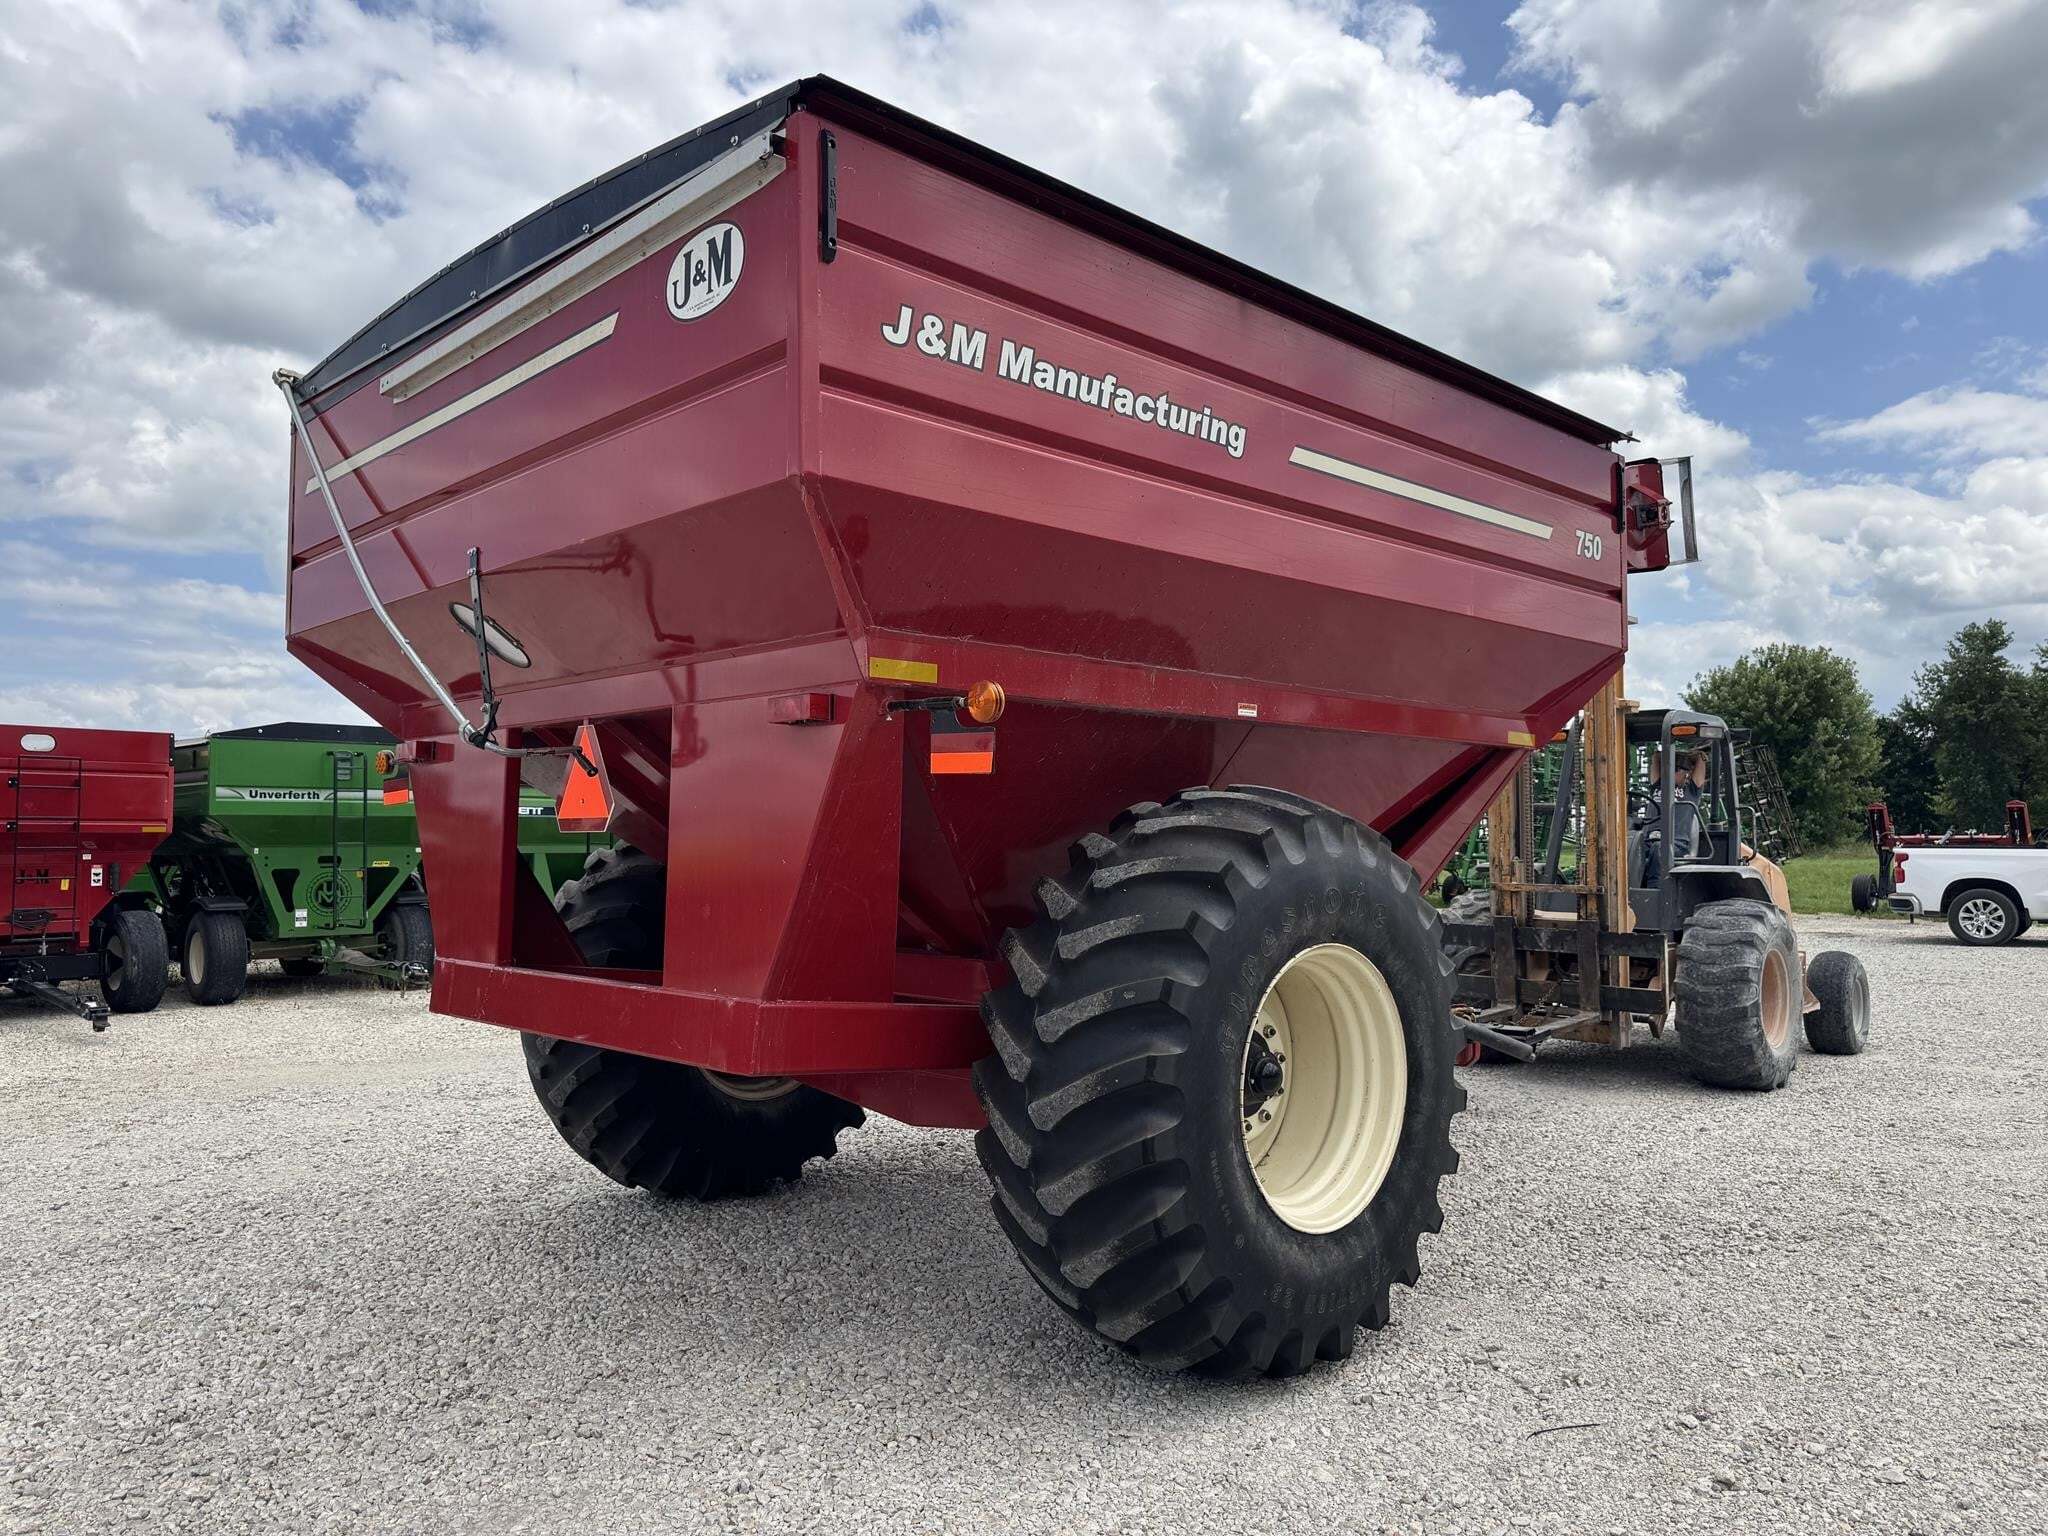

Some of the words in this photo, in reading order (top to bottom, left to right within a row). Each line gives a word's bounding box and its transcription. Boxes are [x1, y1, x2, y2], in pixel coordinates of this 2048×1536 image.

[672, 227, 733, 309] J&M
[881, 304, 988, 371] J&M
[998, 338, 1248, 459] Manufacturing
[1575, 529, 1602, 561] 750
[249, 789, 320, 800] Unverferth
